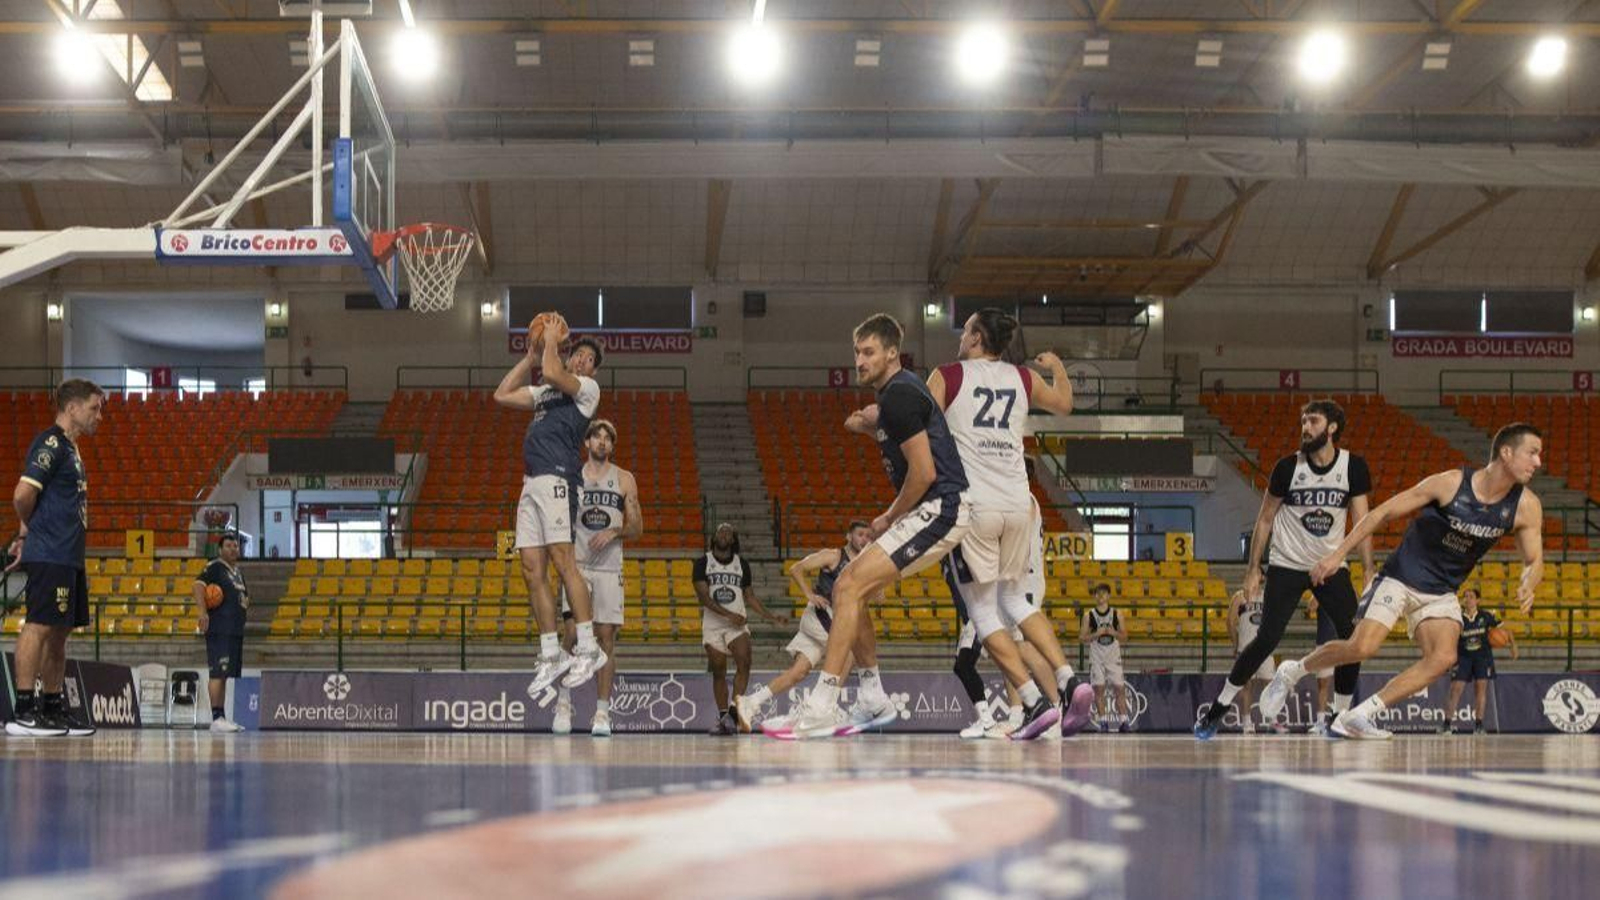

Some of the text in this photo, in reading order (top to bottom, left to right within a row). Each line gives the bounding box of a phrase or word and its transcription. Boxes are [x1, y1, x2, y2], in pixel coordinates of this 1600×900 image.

[201, 234, 318, 250] BricoCentro
[582, 335, 690, 350] OULEVARD
[1395, 340, 1572, 356] GRADA BOULEVARD
[158, 370, 166, 385] 1
[834, 370, 844, 386] 3
[1284, 372, 1294, 387] 4
[1579, 374, 1589, 389] 5
[973, 386, 1017, 429] 27
[554, 485, 566, 498] 13
[1134, 479, 1208, 490] EMERXENCIA
[583, 492, 619, 507] 2005
[136, 534, 145, 554] 1
[1173, 536, 1186, 556] 3
[274, 703, 398, 720] AbrenteDixital
[424, 691, 525, 728] ingade
[1407, 703, 1477, 721] Pendo
